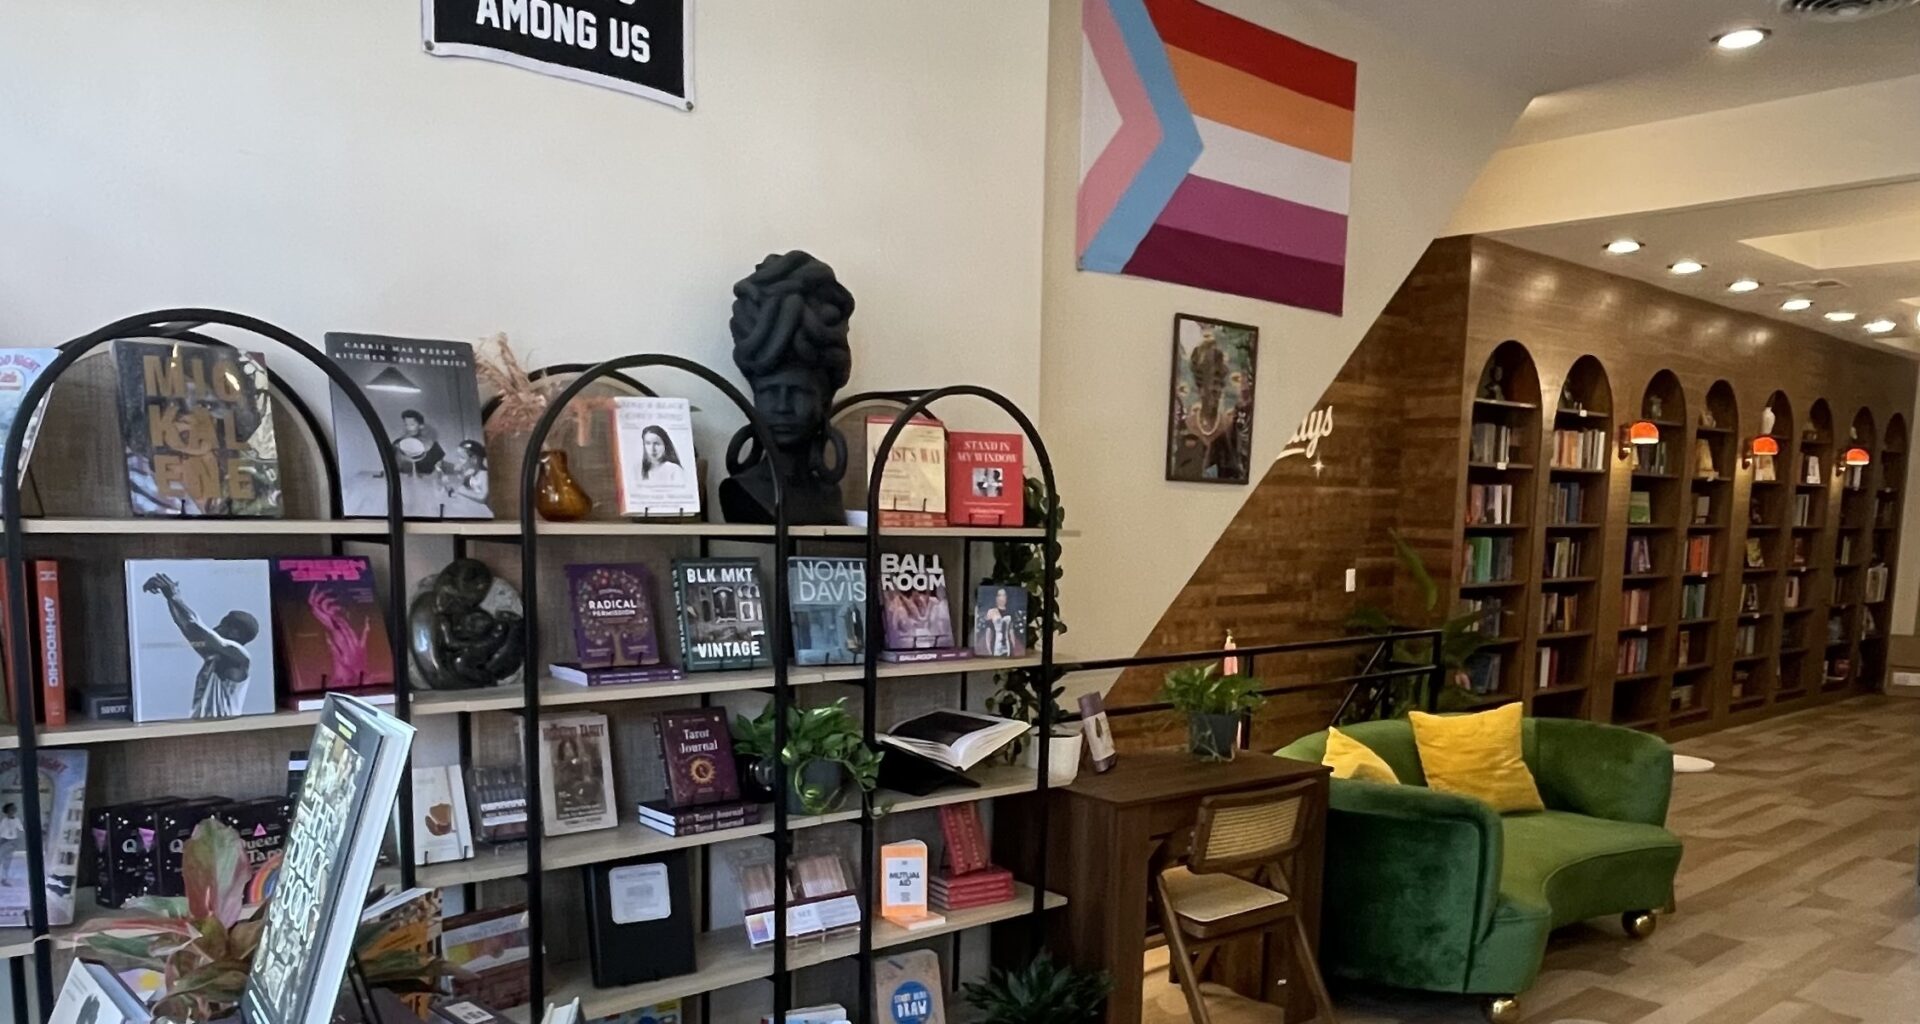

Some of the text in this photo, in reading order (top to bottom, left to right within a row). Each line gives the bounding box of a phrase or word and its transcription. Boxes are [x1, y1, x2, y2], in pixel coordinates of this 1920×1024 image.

[476, 0, 650, 63] AMONG US
[344, 342, 386, 351] CARRIE
[335, 353, 386, 361] KITCHEN
[964, 441, 1010, 451] STAND IN
[957, 452, 1017, 463] MY WINDOW
[687, 568, 753, 583] BLK MKT
[797, 561, 866, 581] NOAH
[881, 574, 945, 591] ROOM
[800, 581, 867, 602] DAVIS
[588, 600, 637, 610] RADICAL
[44, 597, 59, 687] APHROCHIC
[697, 641, 760, 658] VINTAGE
[899, 653, 937, 662] BALLROOM
[683, 729, 709, 740] Tarot
[680, 740, 718, 754] Journal
[695, 807, 744, 823] Tarot Journal
[695, 818, 744, 833] Tarot Journal
[889, 871, 920, 879] MUTUAL
